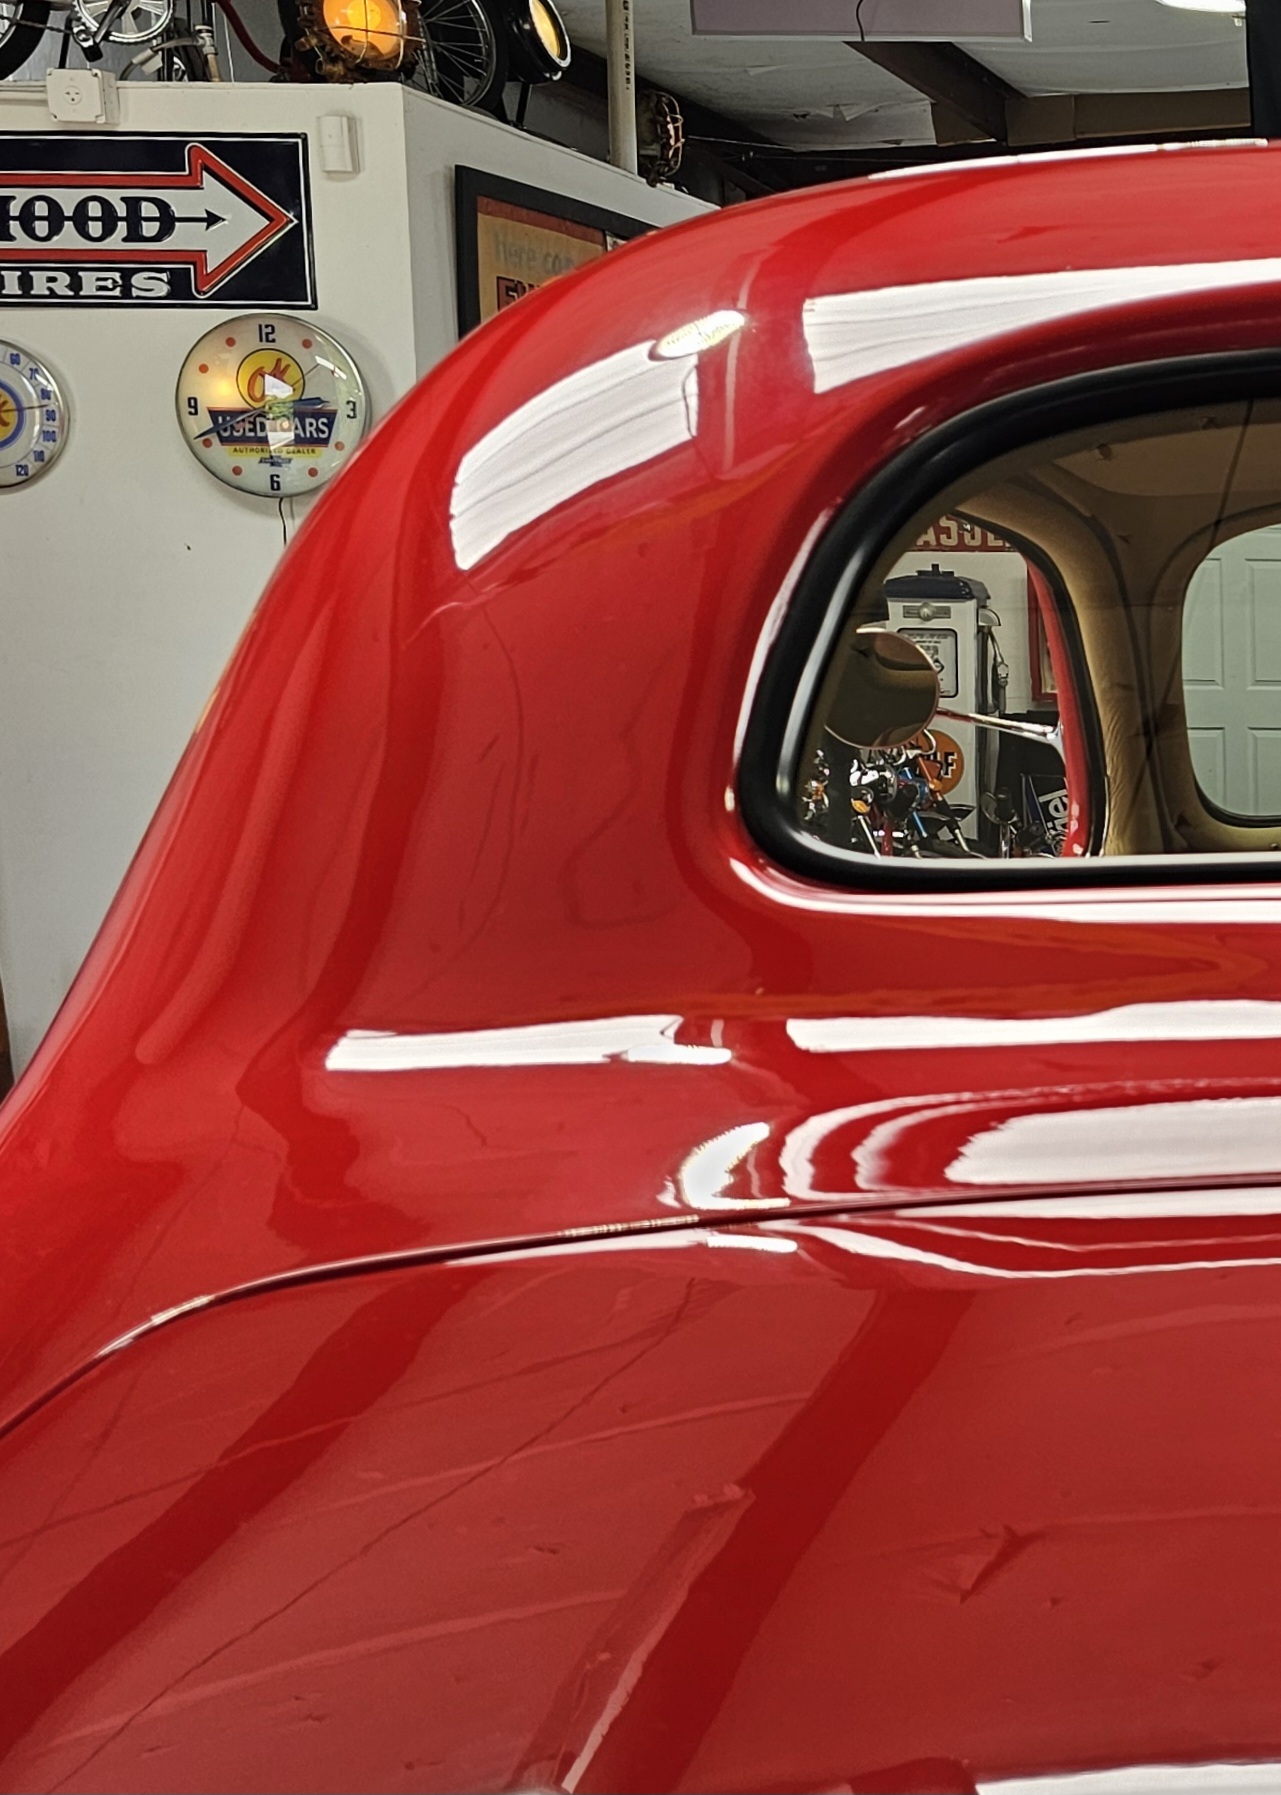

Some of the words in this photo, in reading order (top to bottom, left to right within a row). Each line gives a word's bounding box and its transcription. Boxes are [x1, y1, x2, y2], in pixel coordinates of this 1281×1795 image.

[258, 323, 276, 344] 12
[187, 396, 199, 416] 9
[346, 400, 358, 419] 3
[281, 417, 330, 438] ARS
[270, 473, 281, 492] 6
